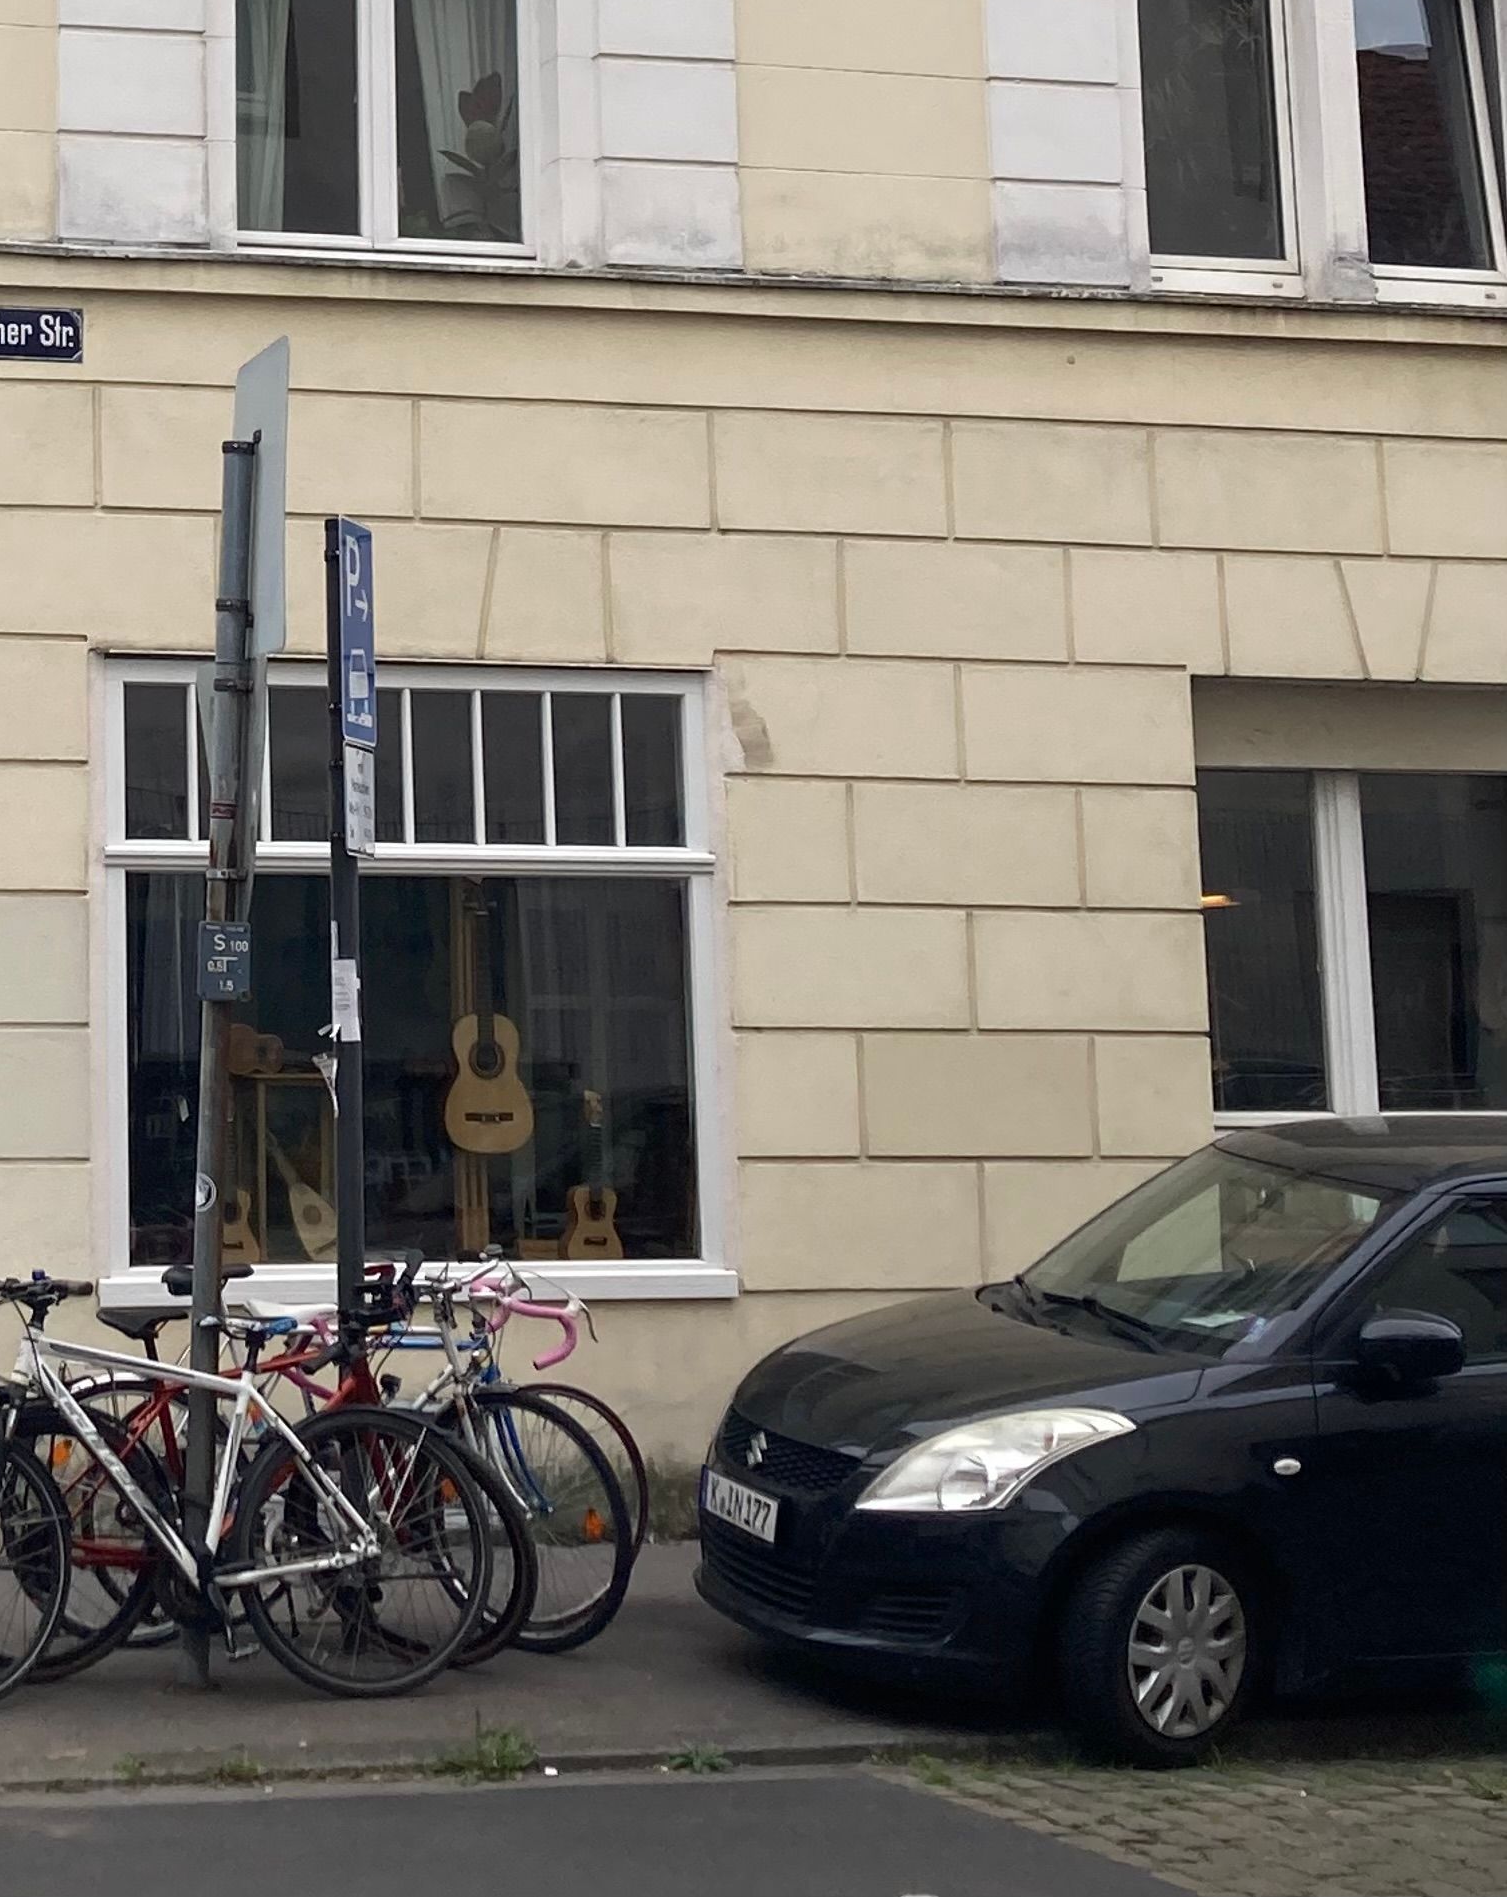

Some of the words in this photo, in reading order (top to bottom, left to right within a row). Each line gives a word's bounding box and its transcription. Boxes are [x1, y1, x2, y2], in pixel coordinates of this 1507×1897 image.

[39, 314, 75, 348] Str.
[346, 534, 360, 616] P
[213, 933, 226, 951] S
[229, 940, 249, 952] 100
